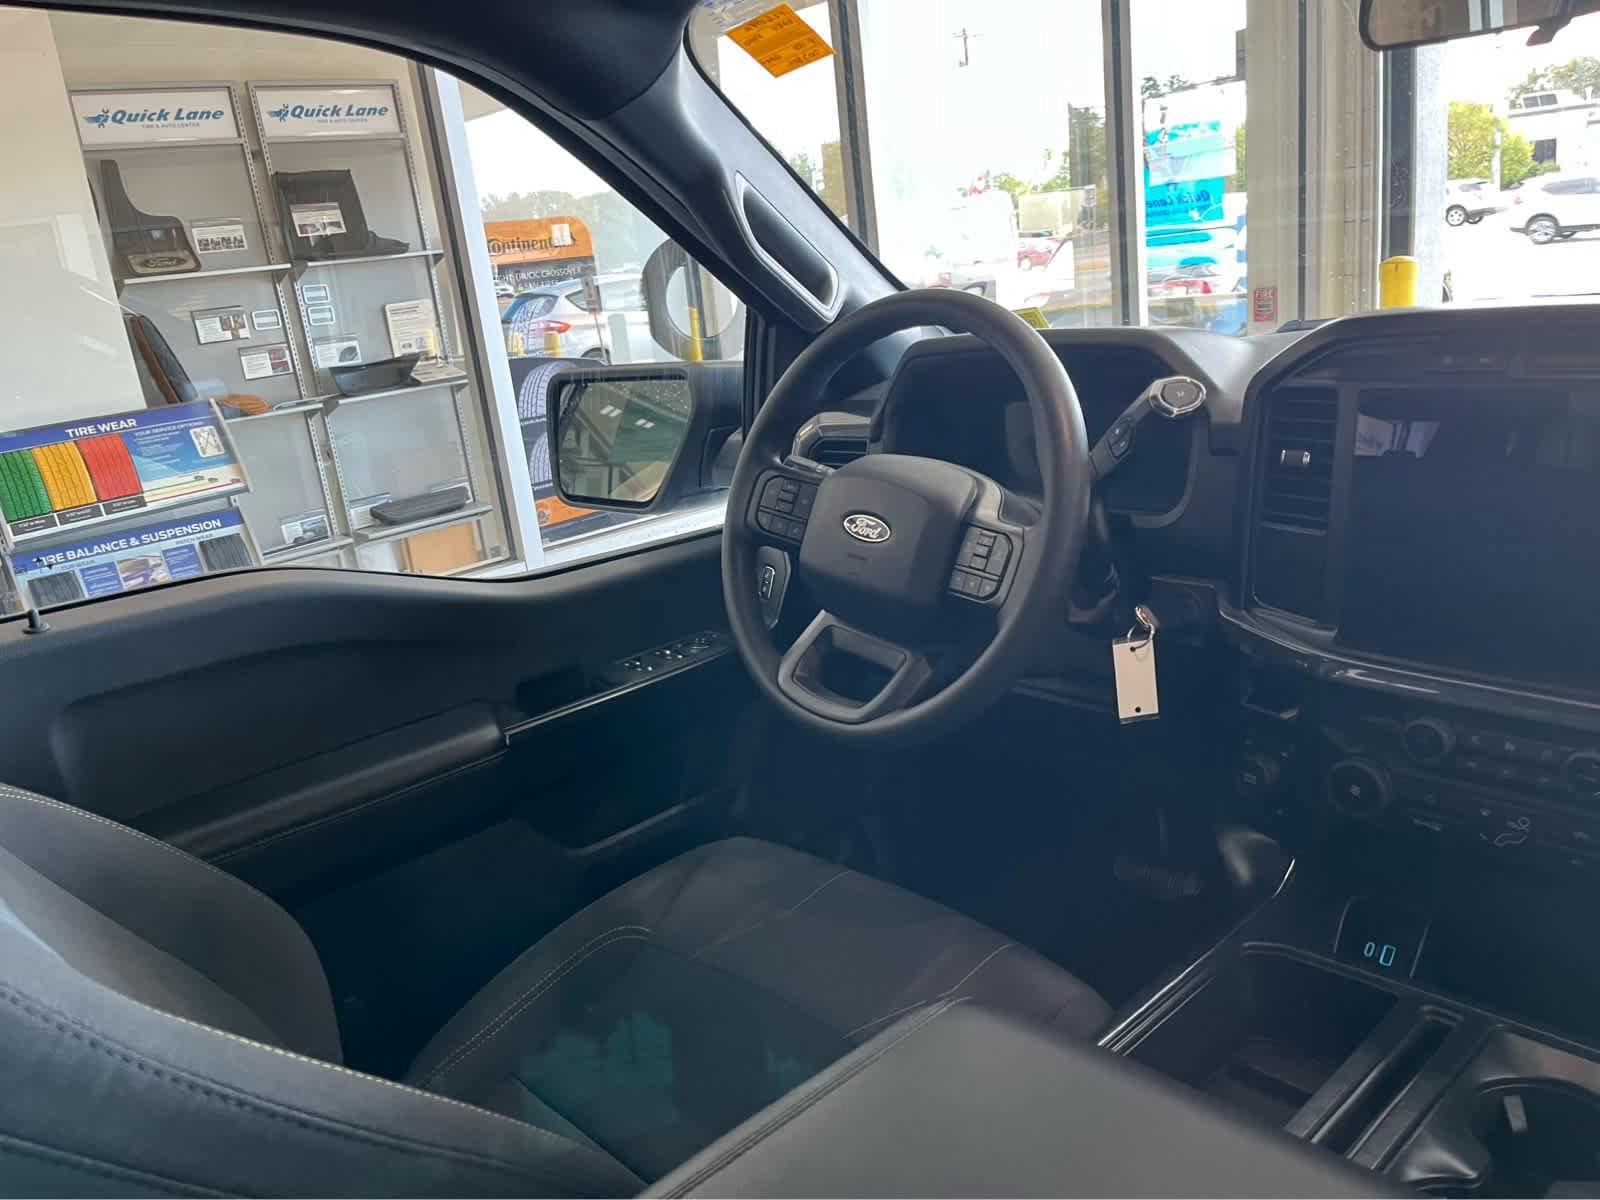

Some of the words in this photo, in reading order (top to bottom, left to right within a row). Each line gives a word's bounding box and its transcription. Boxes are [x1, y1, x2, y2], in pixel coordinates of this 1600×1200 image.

[111, 108, 170, 124] Quick
[174, 107, 225, 121] Lane
[290, 104, 342, 119] Quick
[345, 103, 389, 117] Lane
[65, 425, 97, 439] TIRE
[98, 418, 137, 433] WEAR
[850, 517, 882, 539] Ford
[66, 539, 129, 560] BALANCE
[130, 536, 140, 546] &
[142, 518, 222, 544] SUSPENSION
